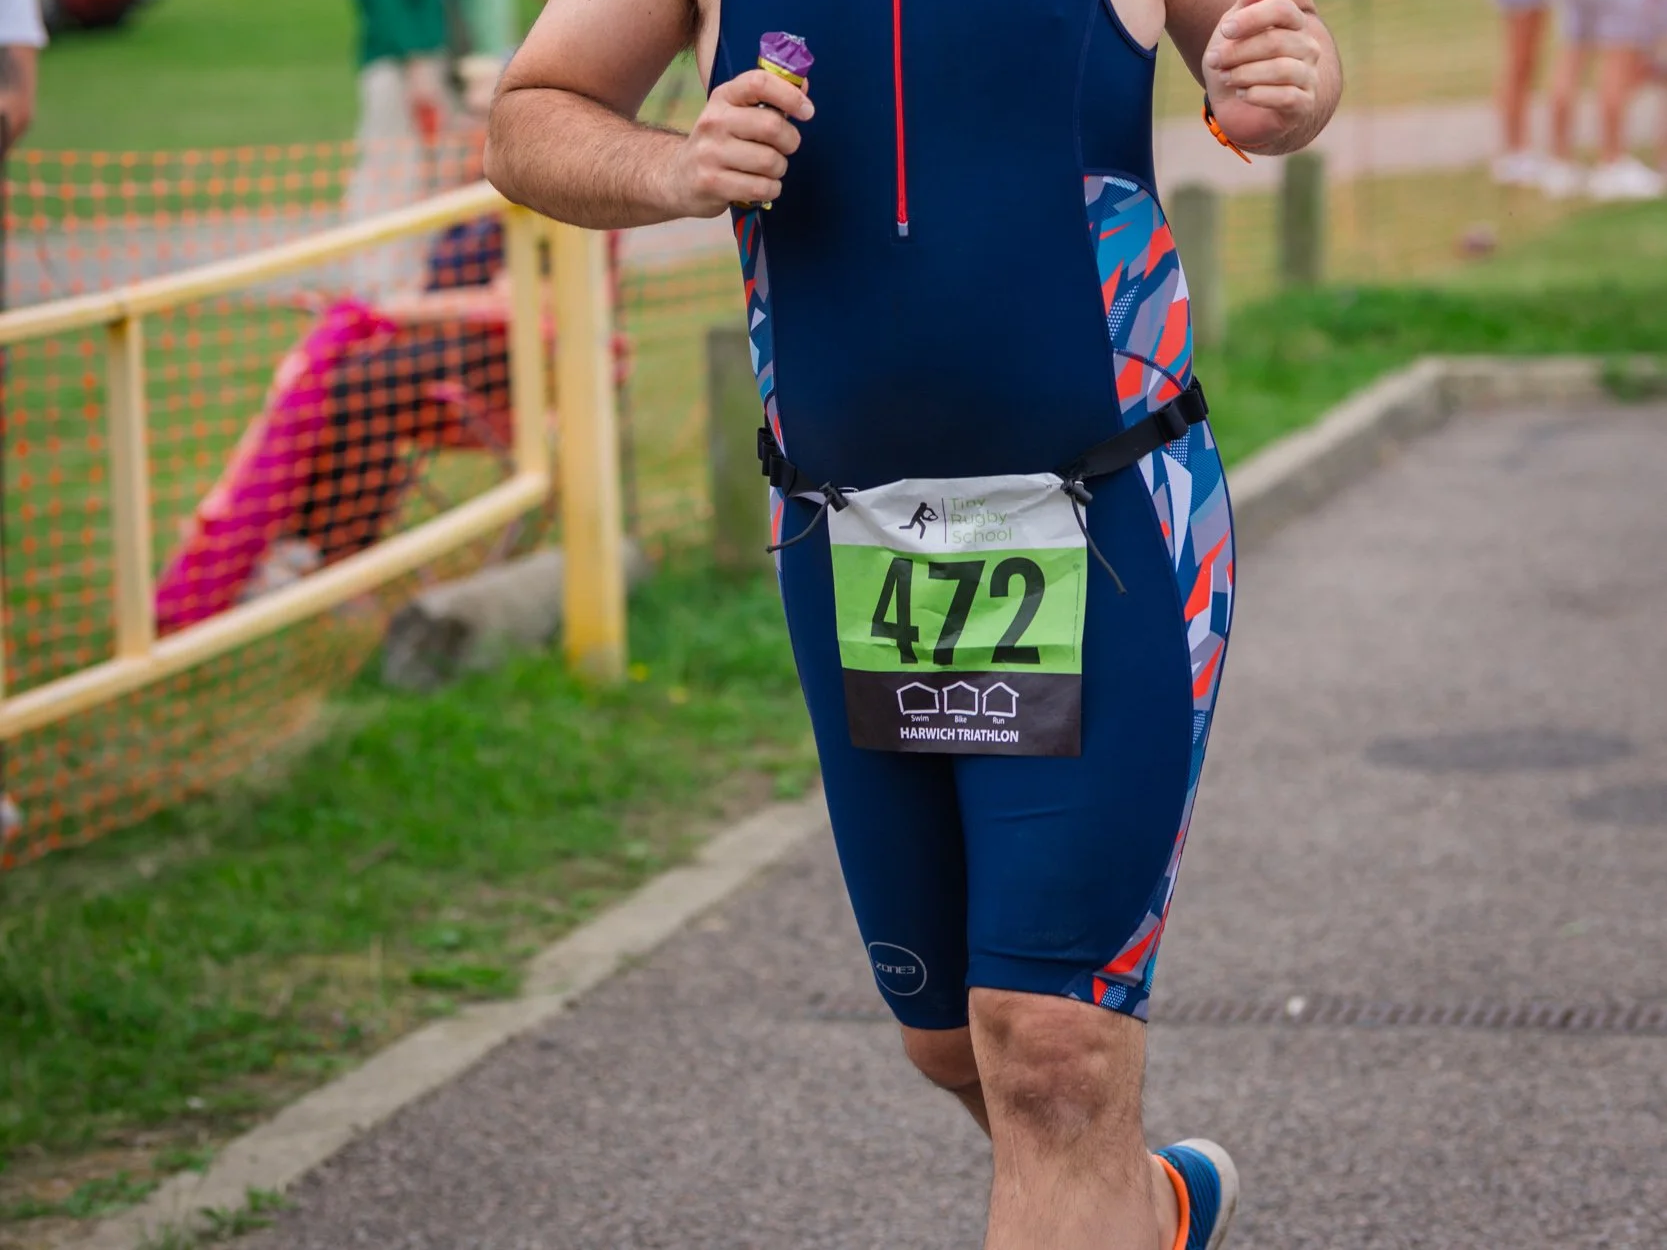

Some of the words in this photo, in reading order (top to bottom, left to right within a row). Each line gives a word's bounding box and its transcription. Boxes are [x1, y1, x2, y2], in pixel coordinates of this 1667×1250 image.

[951, 497, 986, 511] Tiny
[950, 509, 1007, 527] Rugby
[952, 526, 1012, 544] School
[870, 557, 1045, 665] 472
[910, 715, 930, 723] Swim
[954, 715, 967, 724] Bike
[992, 717, 1005, 725] Run
[900, 727, 955, 740] HARWICH
[957, 729, 1019, 743] TRIATHLON
